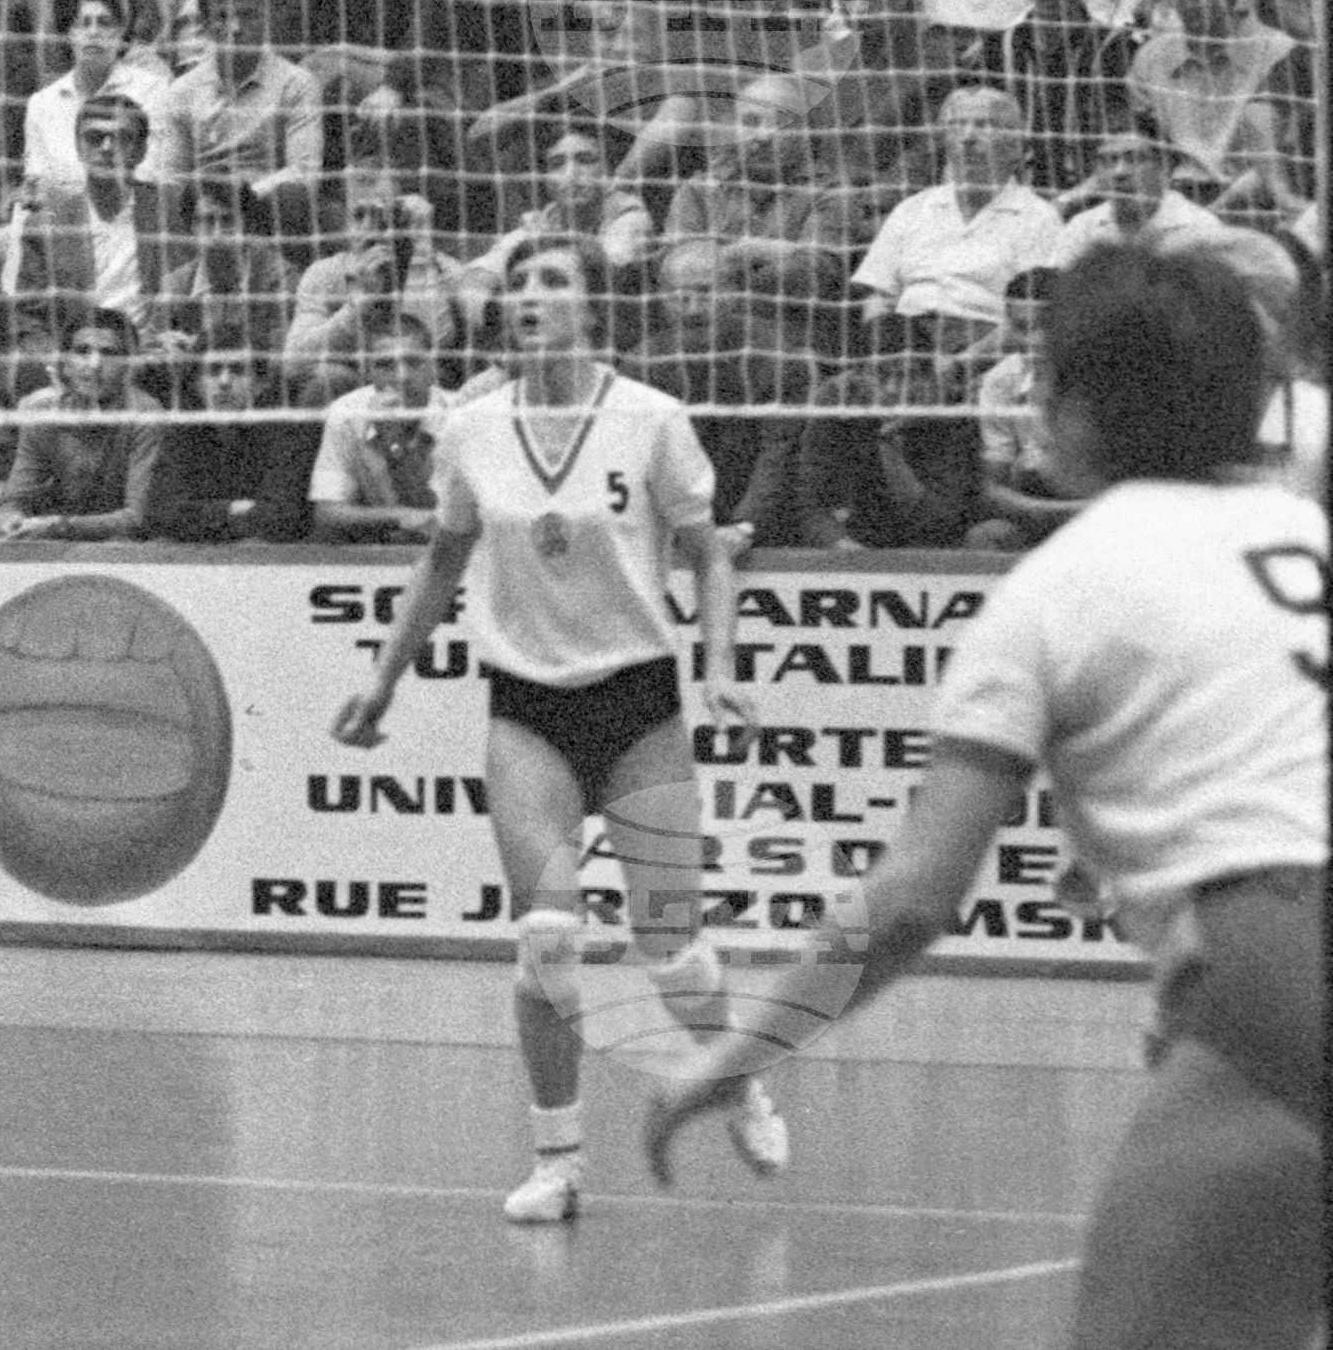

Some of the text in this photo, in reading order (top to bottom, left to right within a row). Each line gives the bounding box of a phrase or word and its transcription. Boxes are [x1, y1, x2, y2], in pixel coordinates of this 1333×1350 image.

[606, 470, 630, 514] 5
[693, 725, 931, 769] ORTE
[251, 878, 428, 920] RUE
